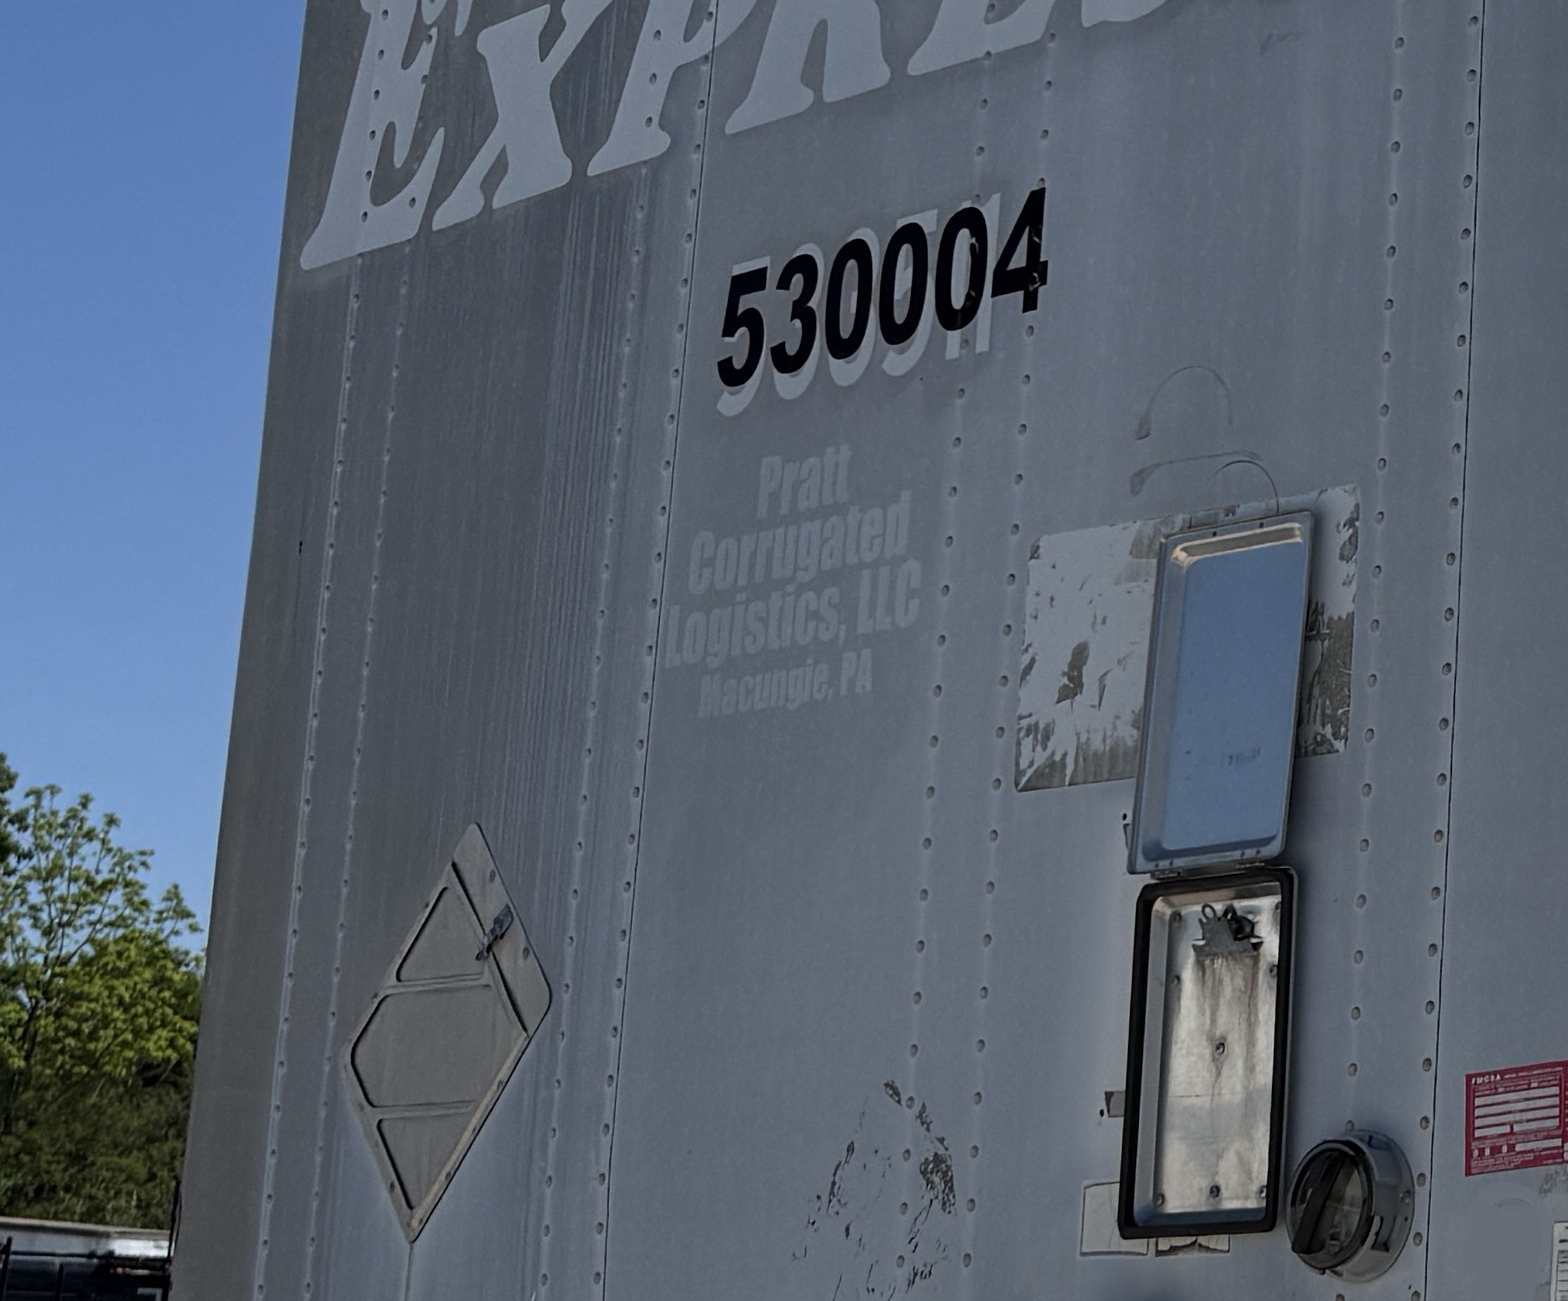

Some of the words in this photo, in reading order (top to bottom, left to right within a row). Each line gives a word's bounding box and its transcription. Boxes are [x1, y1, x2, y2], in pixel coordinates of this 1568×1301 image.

[717, 186, 1049, 388] 530004
[757, 444, 851, 519] Pratt
[688, 490, 912, 595] Corrugated
[665, 582, 847, 669] Logistics,
[856, 558, 922, 635] LLC
[840, 647, 873, 697] PA
